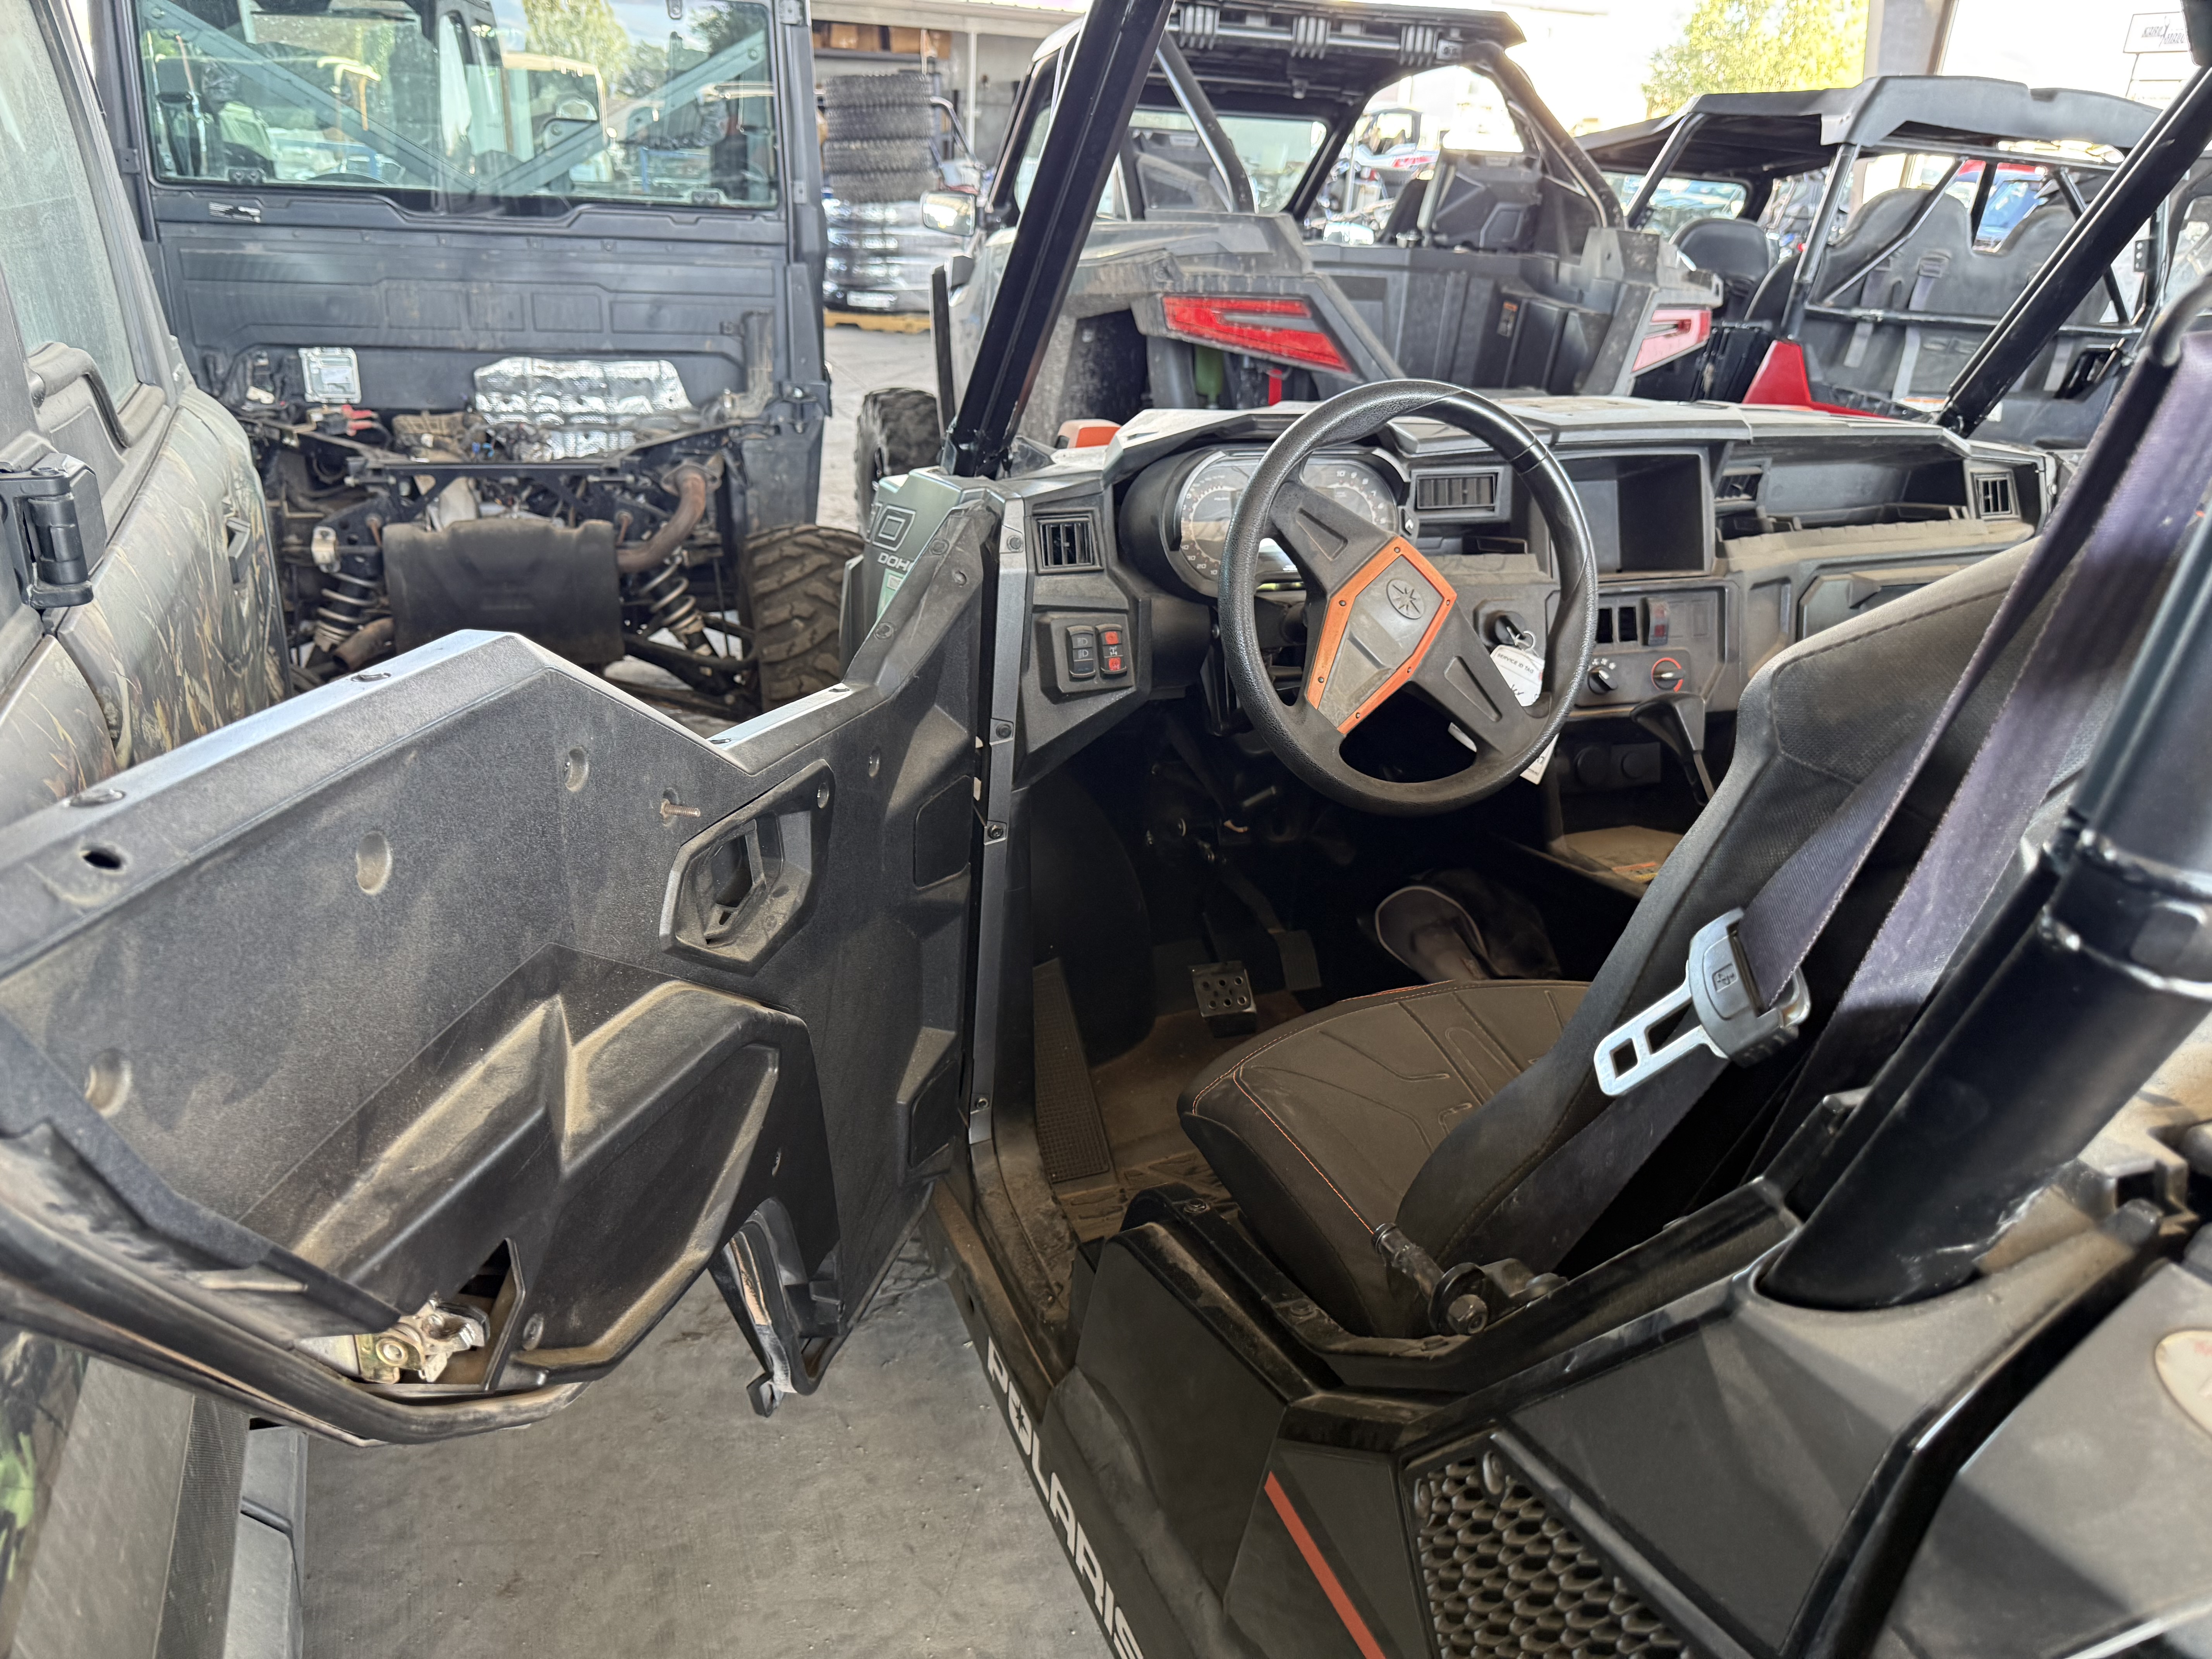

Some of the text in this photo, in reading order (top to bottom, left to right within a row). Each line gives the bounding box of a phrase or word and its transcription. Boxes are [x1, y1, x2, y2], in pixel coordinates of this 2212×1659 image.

[1497, 653, 1518, 666] SERVICE
[1524, 666, 1534, 674] TAG
[988, 1336, 1144, 1659] POLARIS
